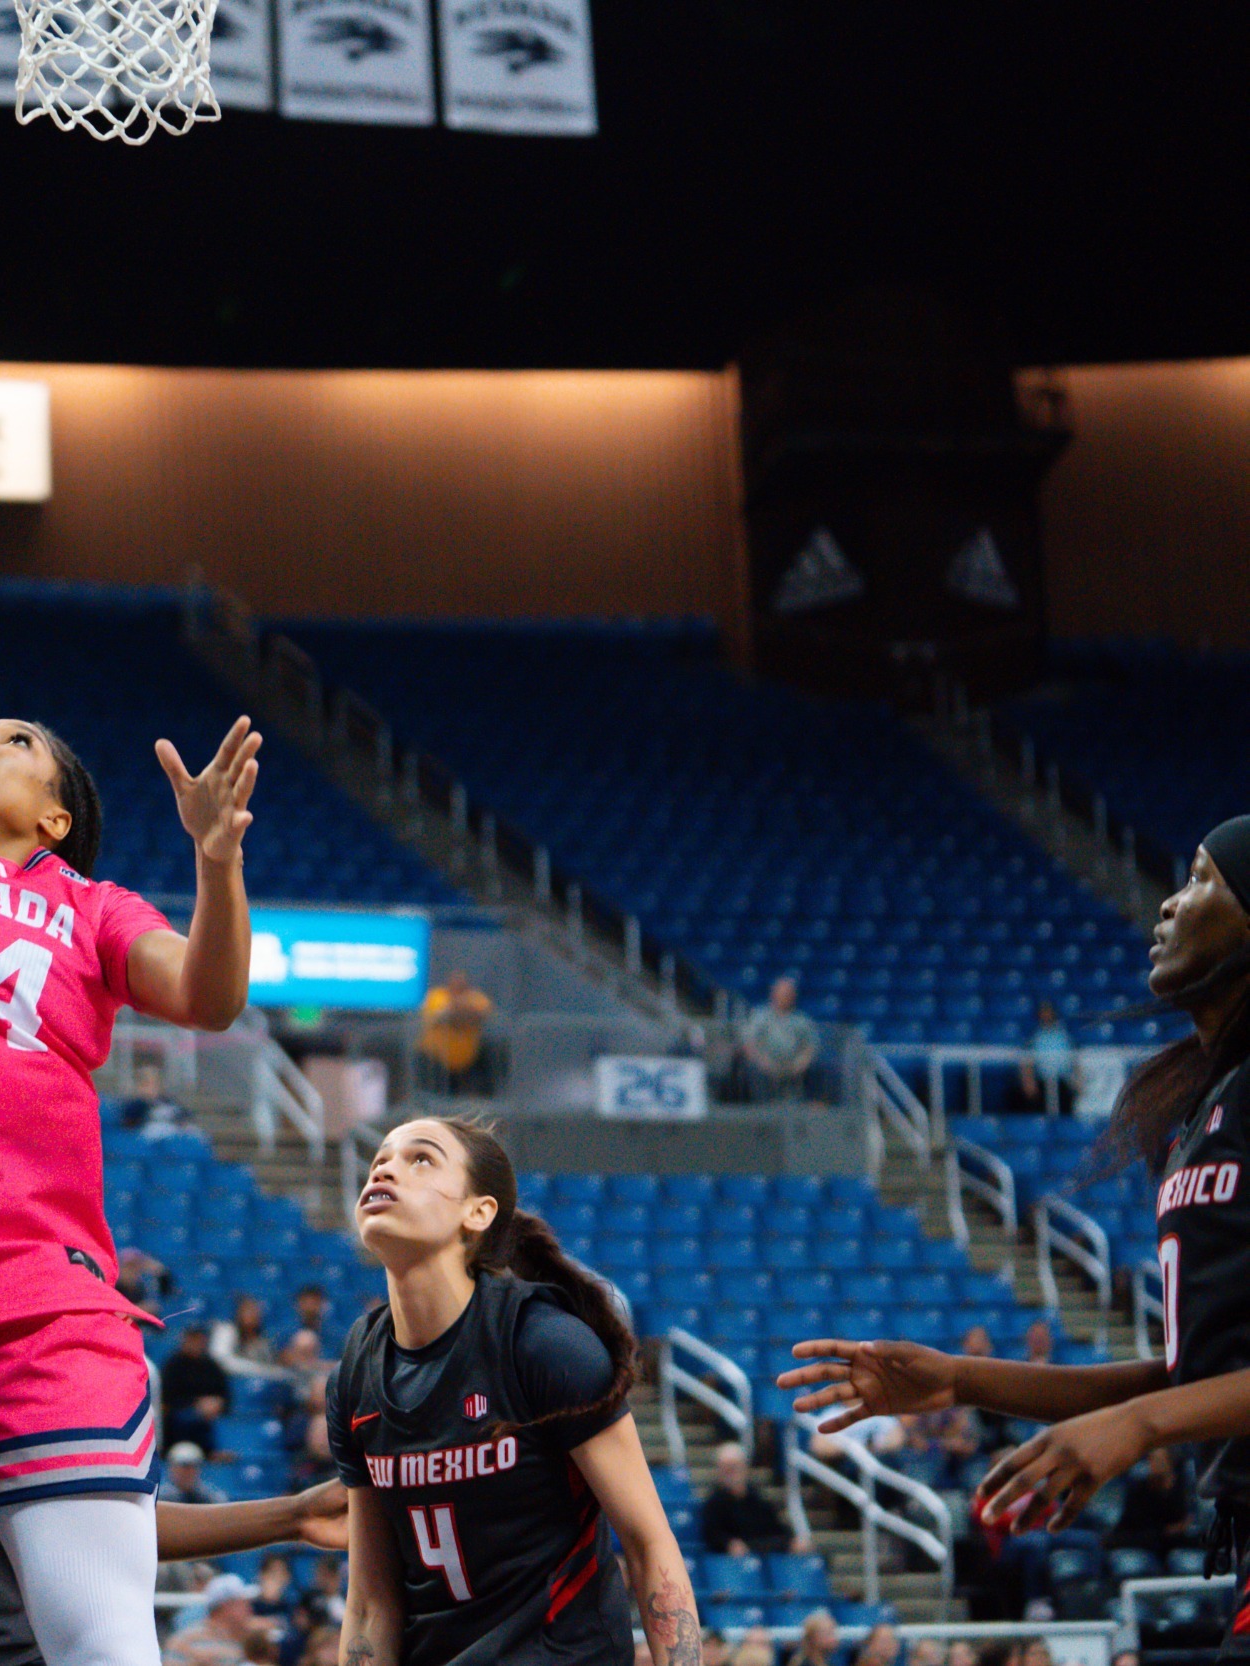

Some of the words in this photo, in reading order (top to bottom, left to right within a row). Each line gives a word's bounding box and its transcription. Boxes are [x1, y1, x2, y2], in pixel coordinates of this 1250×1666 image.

[614, 1062, 687, 1111] 26
[365, 1455, 394, 1488] EW
[400, 1435, 518, 1488] MEXICO
[408, 1502, 474, 1602] 4
